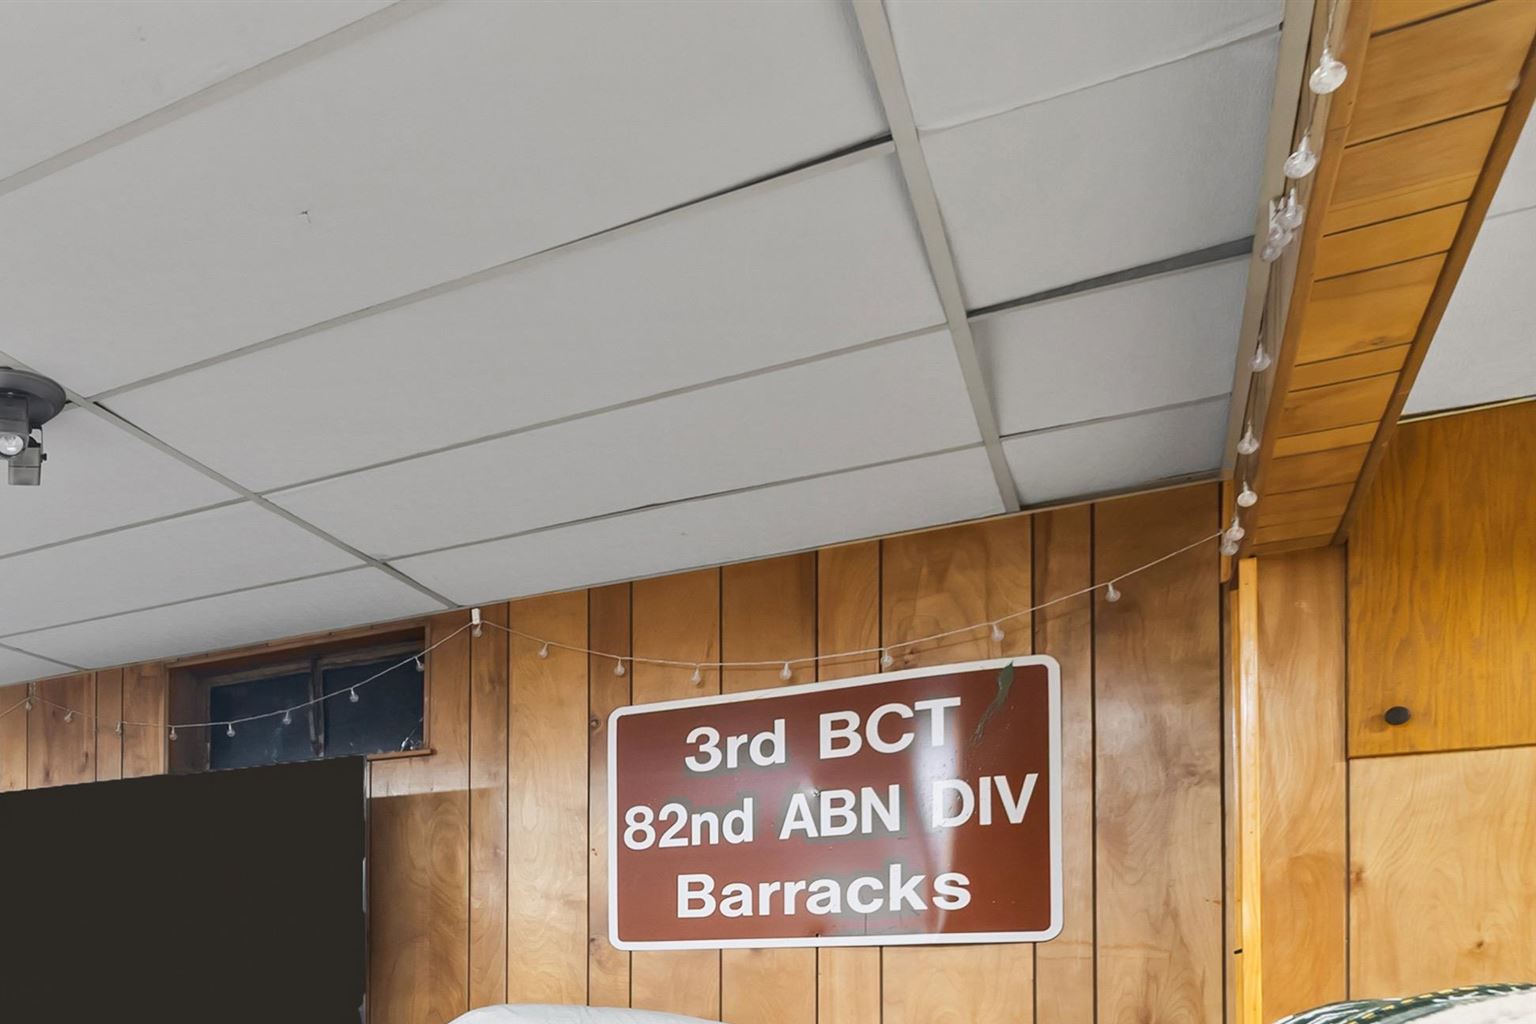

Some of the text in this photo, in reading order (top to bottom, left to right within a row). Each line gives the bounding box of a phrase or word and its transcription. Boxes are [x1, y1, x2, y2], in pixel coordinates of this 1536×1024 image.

[684, 696, 962, 772] 3rd BCT
[623, 772, 1039, 851] 82nd ABN DIV
[676, 864, 972, 919] Barracks
